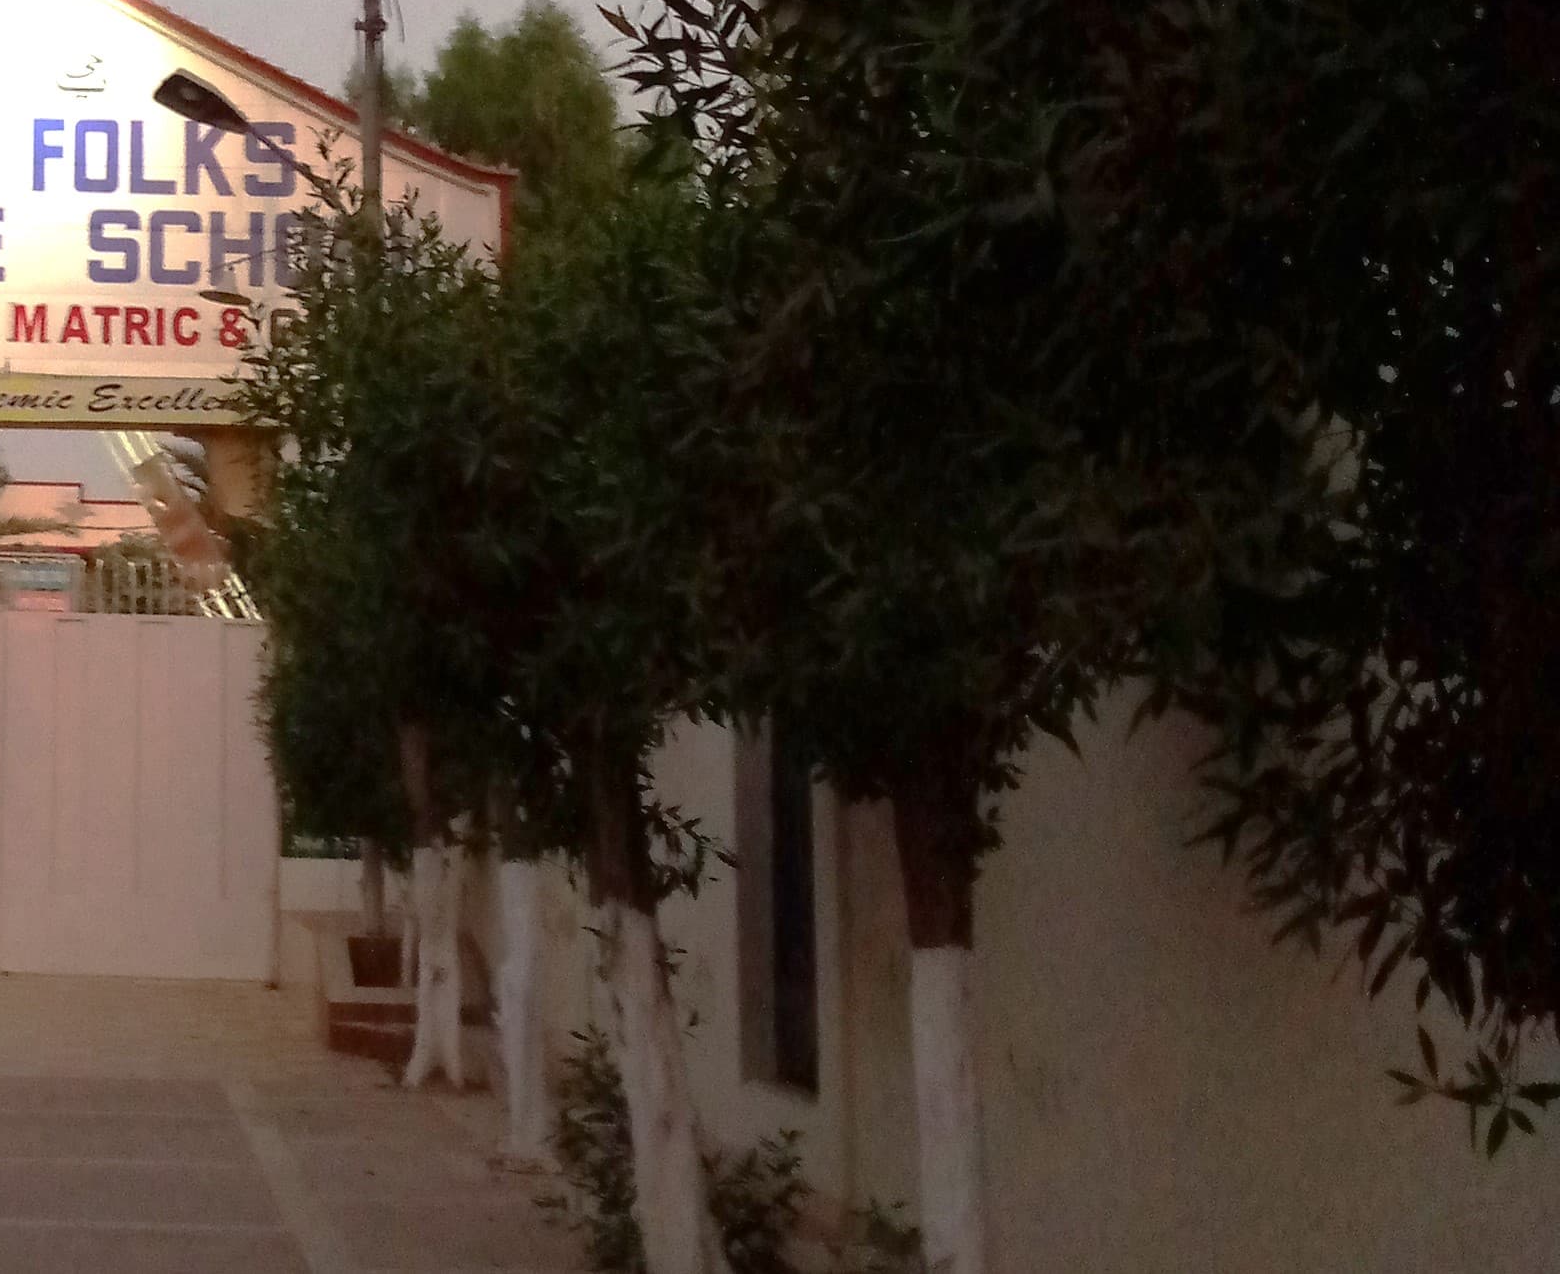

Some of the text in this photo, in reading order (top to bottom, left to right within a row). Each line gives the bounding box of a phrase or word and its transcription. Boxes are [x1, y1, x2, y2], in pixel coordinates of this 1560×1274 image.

[32, 118, 296, 197] FOLKS
[7, 302, 200, 347] MATRIC
[217, 307, 248, 348] &
